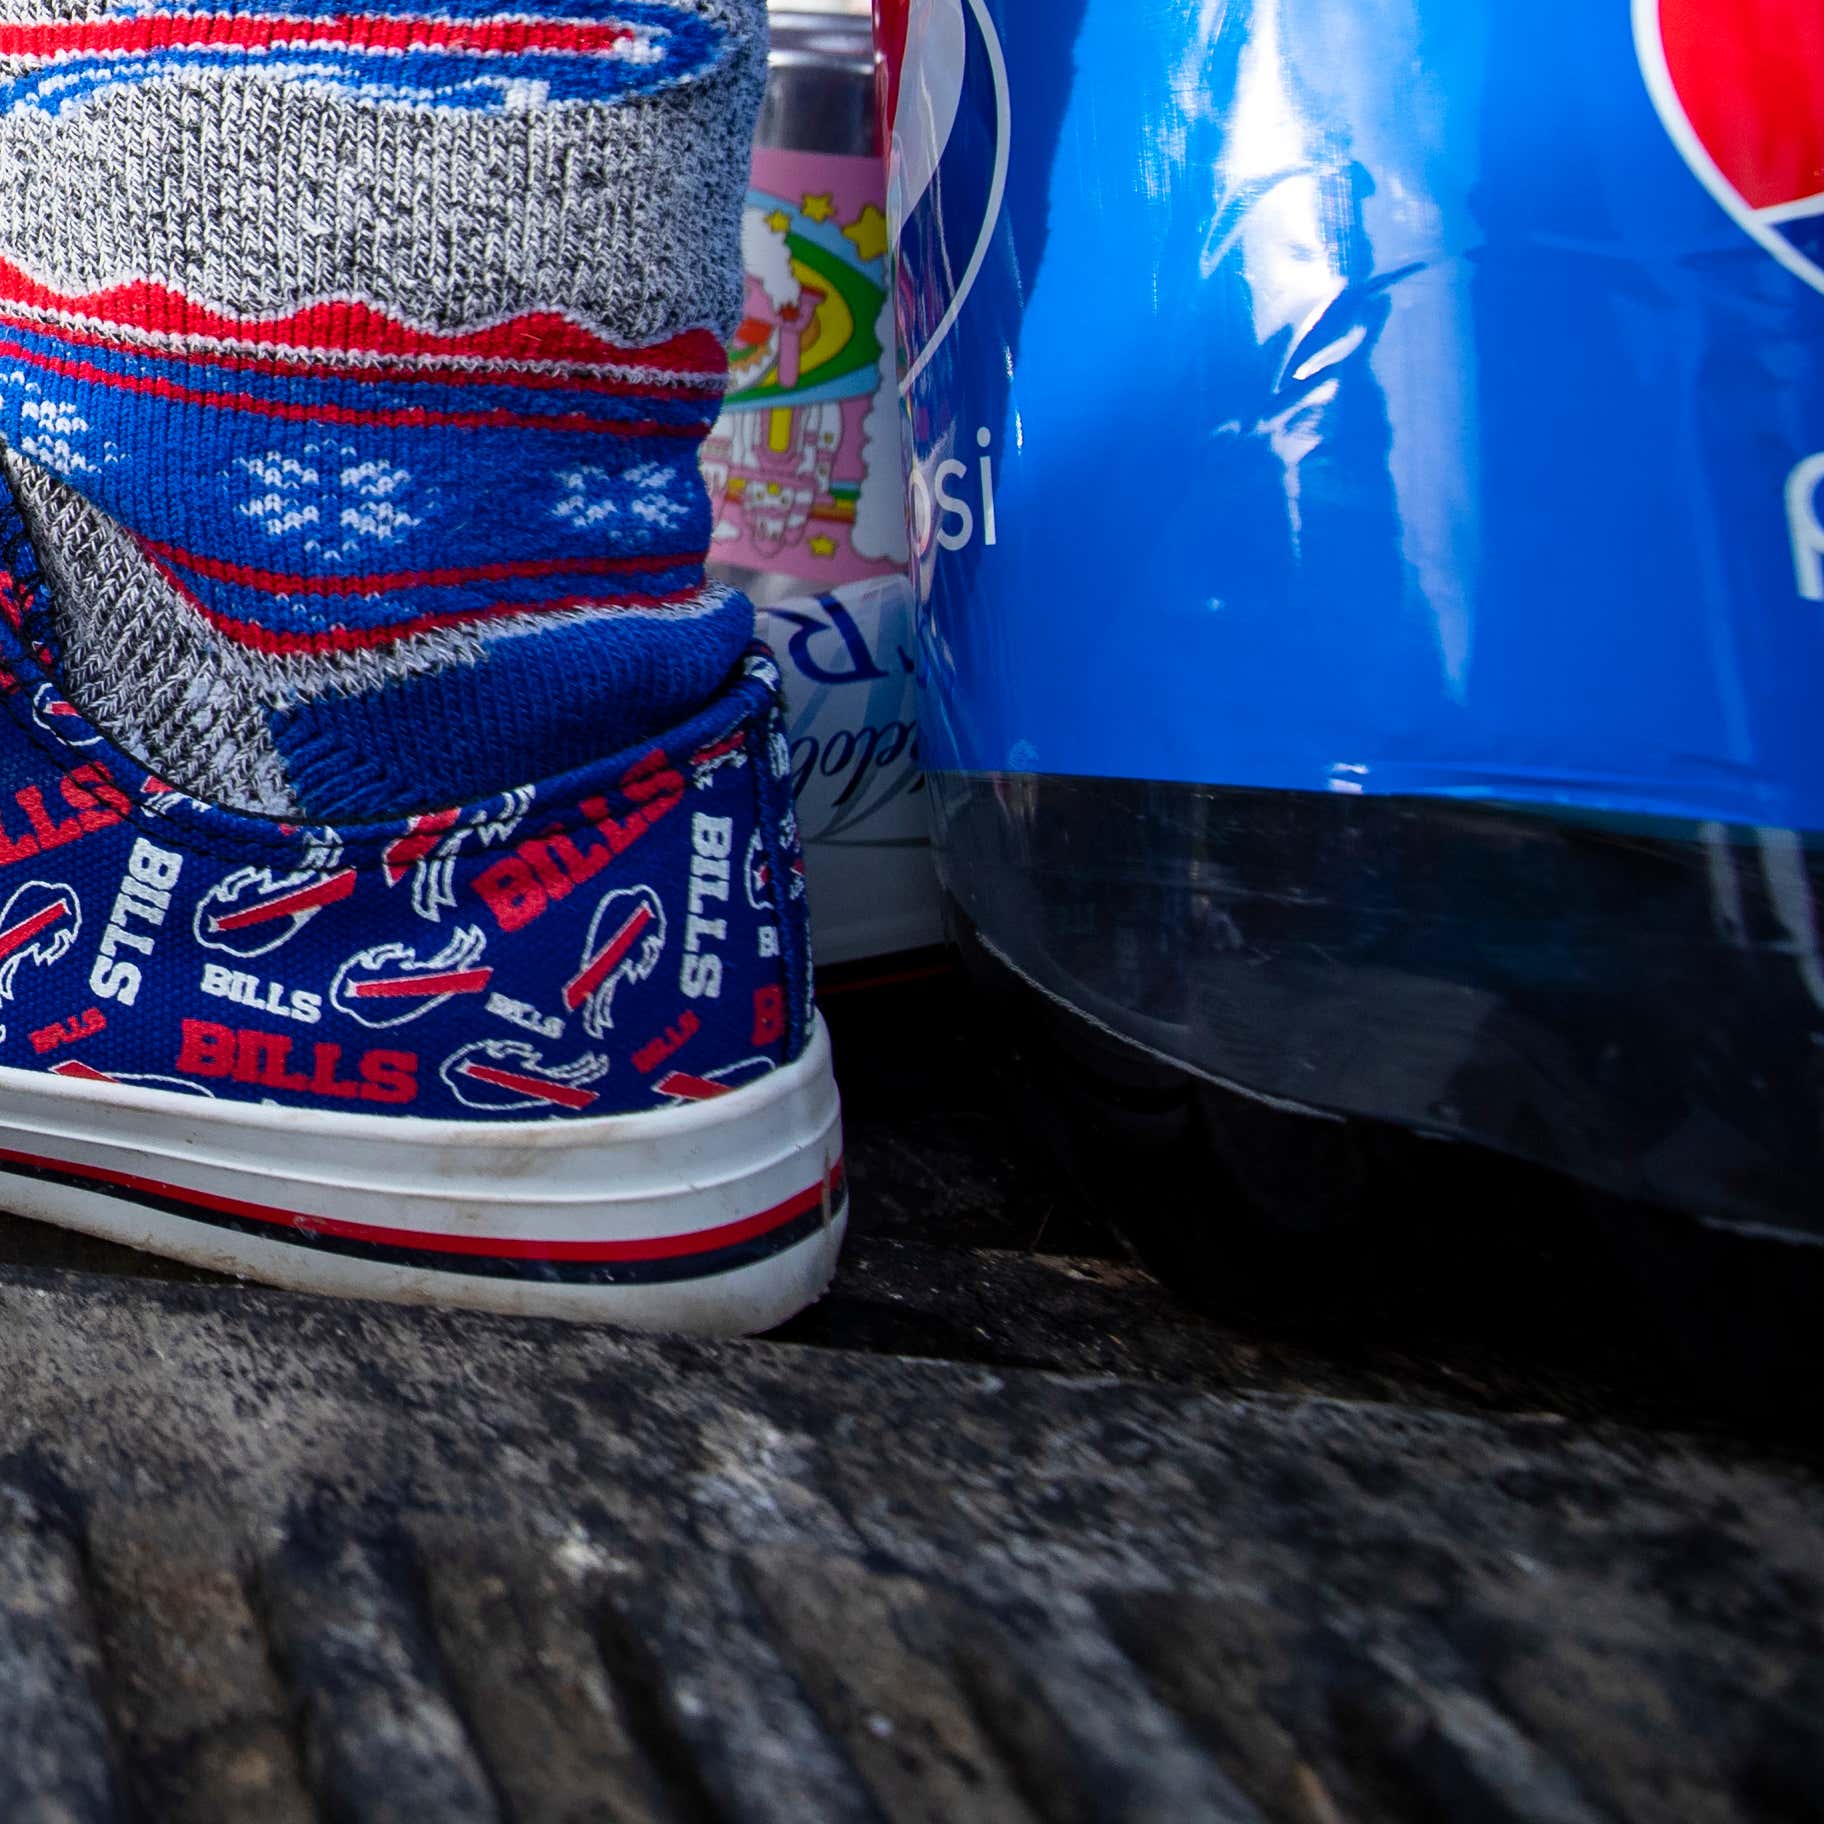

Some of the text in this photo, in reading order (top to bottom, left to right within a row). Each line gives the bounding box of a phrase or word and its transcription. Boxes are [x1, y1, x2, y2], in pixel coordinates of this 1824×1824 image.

[470, 748, 685, 933] BILLS
[88, 836, 184, 1007] BILLS
[680, 811, 733, 999] BILLS
[28, 1006, 108, 1055] BILLS
[200, 962, 323, 1025] BILLS
[484, 991, 566, 1040] BILLS
[176, 1017, 419, 1104] BILLS
[630, 1008, 701, 1074] BILLS
